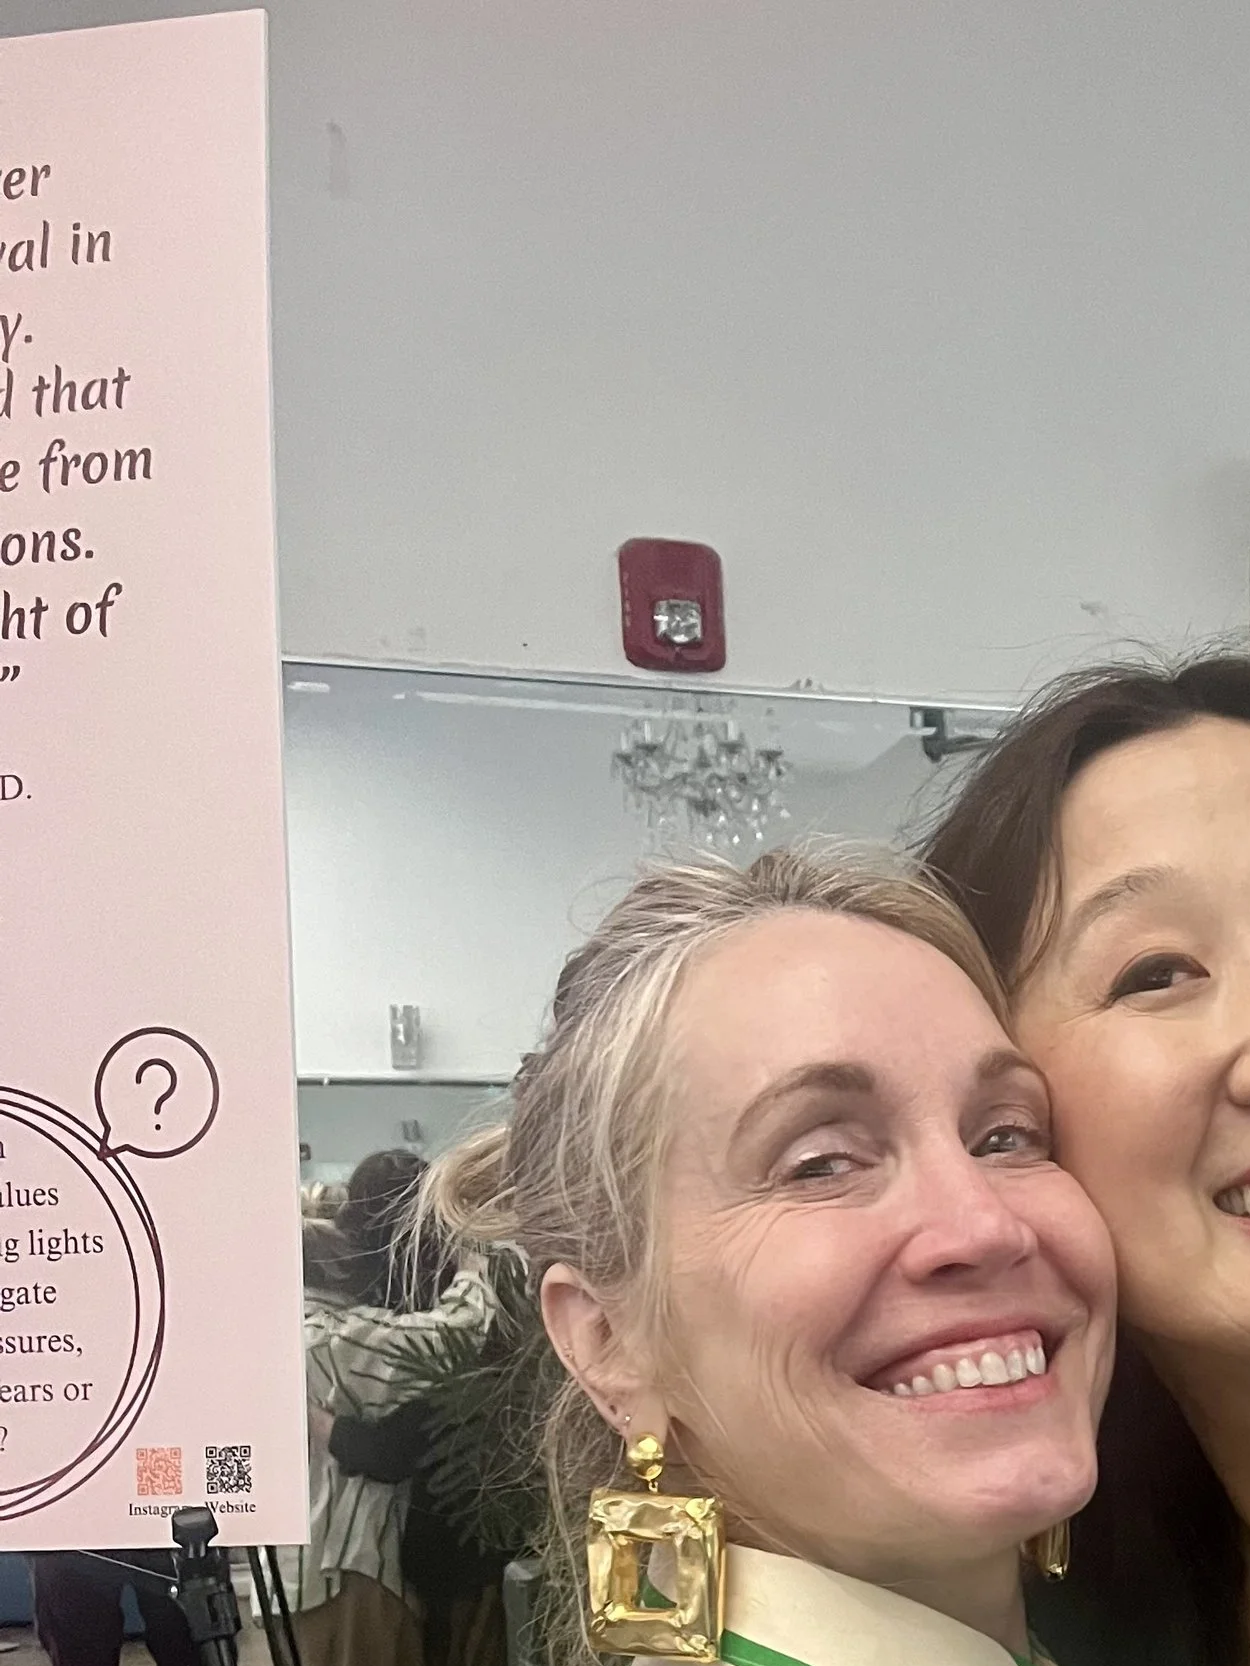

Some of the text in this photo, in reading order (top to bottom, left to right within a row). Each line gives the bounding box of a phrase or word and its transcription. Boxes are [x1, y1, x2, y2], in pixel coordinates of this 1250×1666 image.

[0, 164, 51, 200] er
[0, 220, 111, 272] al in
[32, 364, 131, 418] that
[39, 438, 152, 494] from
[66, 582, 123, 638] of
[0, 1181, 59, 1208] lues
[28, 1228, 104, 1262] lights
[63, 1382, 93, 1401] or
